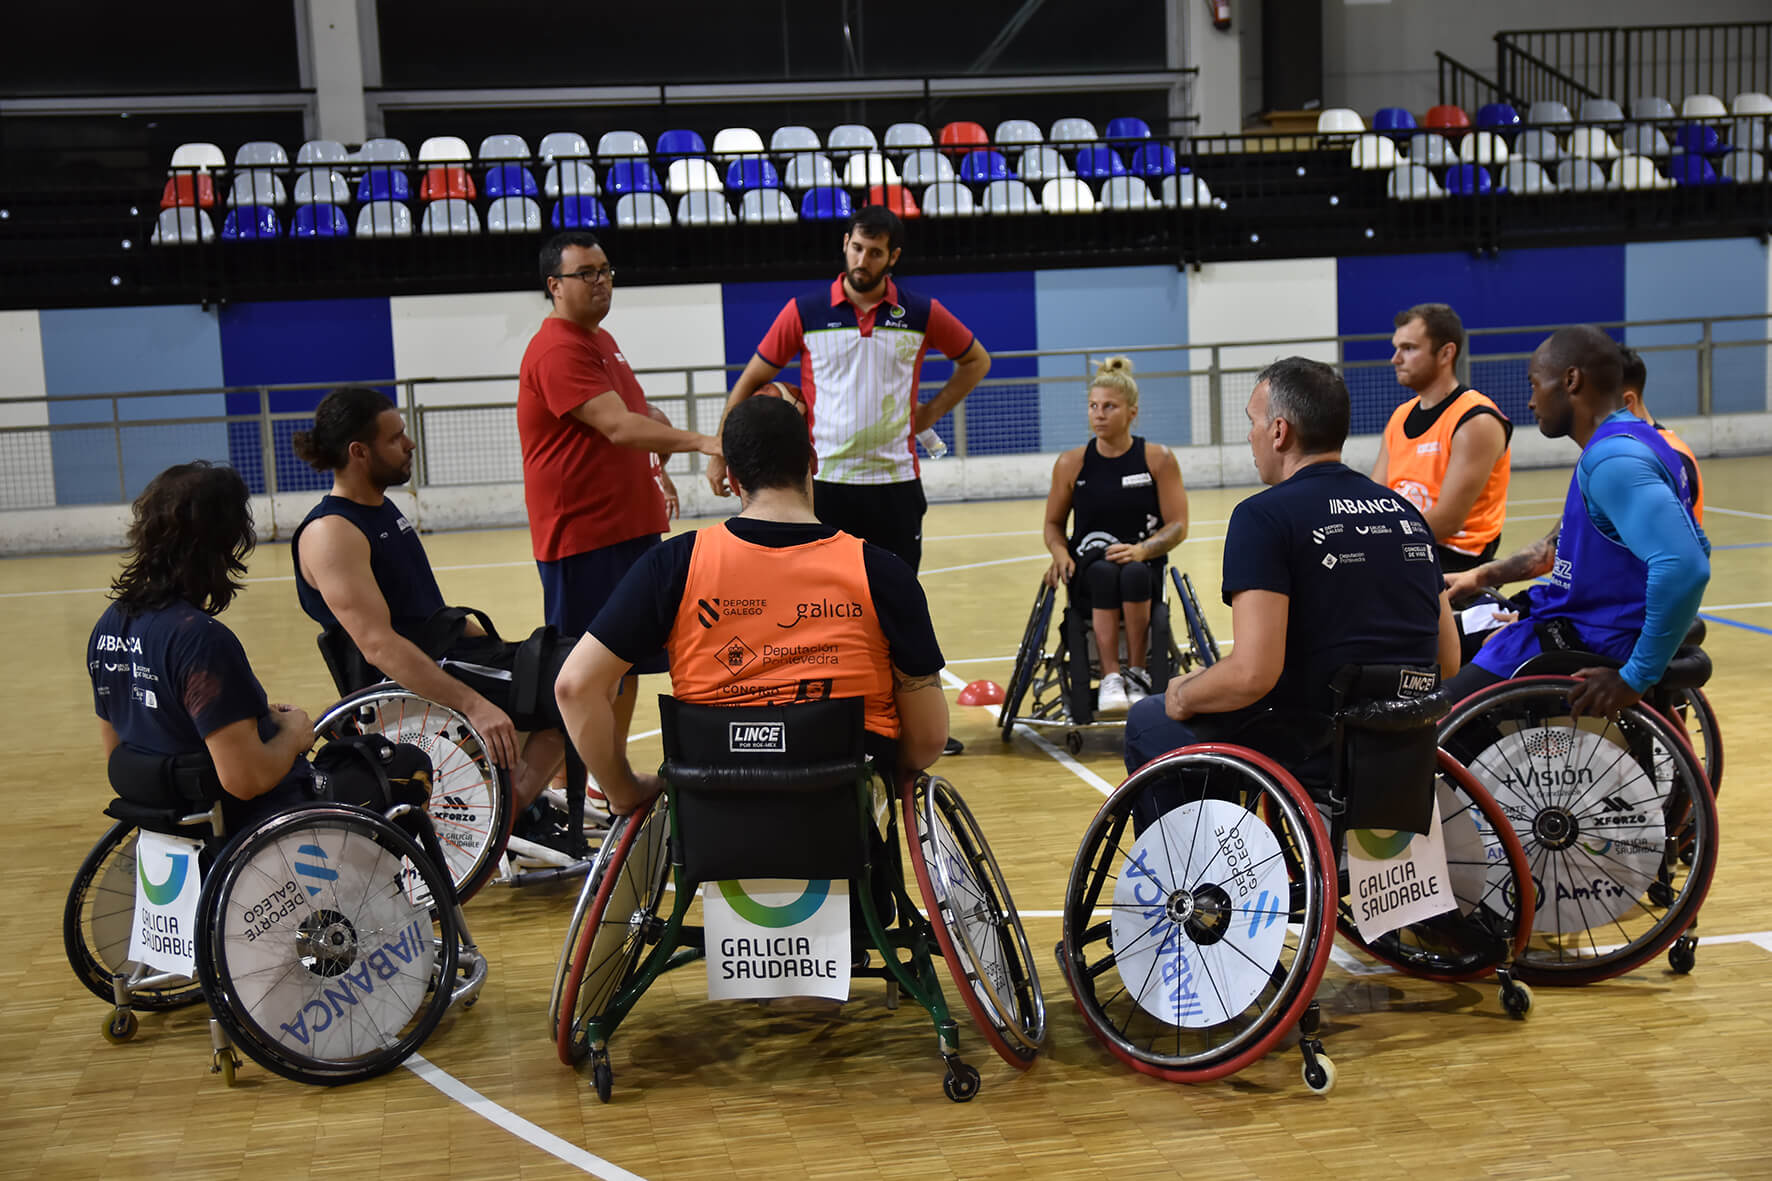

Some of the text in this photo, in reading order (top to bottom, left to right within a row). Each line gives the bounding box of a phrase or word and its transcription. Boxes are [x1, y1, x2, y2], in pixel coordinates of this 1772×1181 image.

[723, 599, 767, 607] DEPORTE
[723, 607, 763, 616] GALEGO
[1402, 675, 1433, 691] LINCE
[734, 726, 780, 742] LINCE
[434, 812, 476, 822] XFORZO
[1594, 814, 1646, 826] XFORZO
[1214, 825, 1248, 897] DEPORTE
[1229, 827, 1258, 890] GALEGO
[1359, 861, 1416, 898] GALICIA
[1361, 876, 1439, 921] SAUDABLE
[1555, 879, 1625, 901] Amfiv
[243, 881, 297, 923] GALEGO
[244, 893, 305, 942] DEPORTE
[721, 937, 810, 957] GALICIA
[722, 959, 837, 979] SAUDABLE
